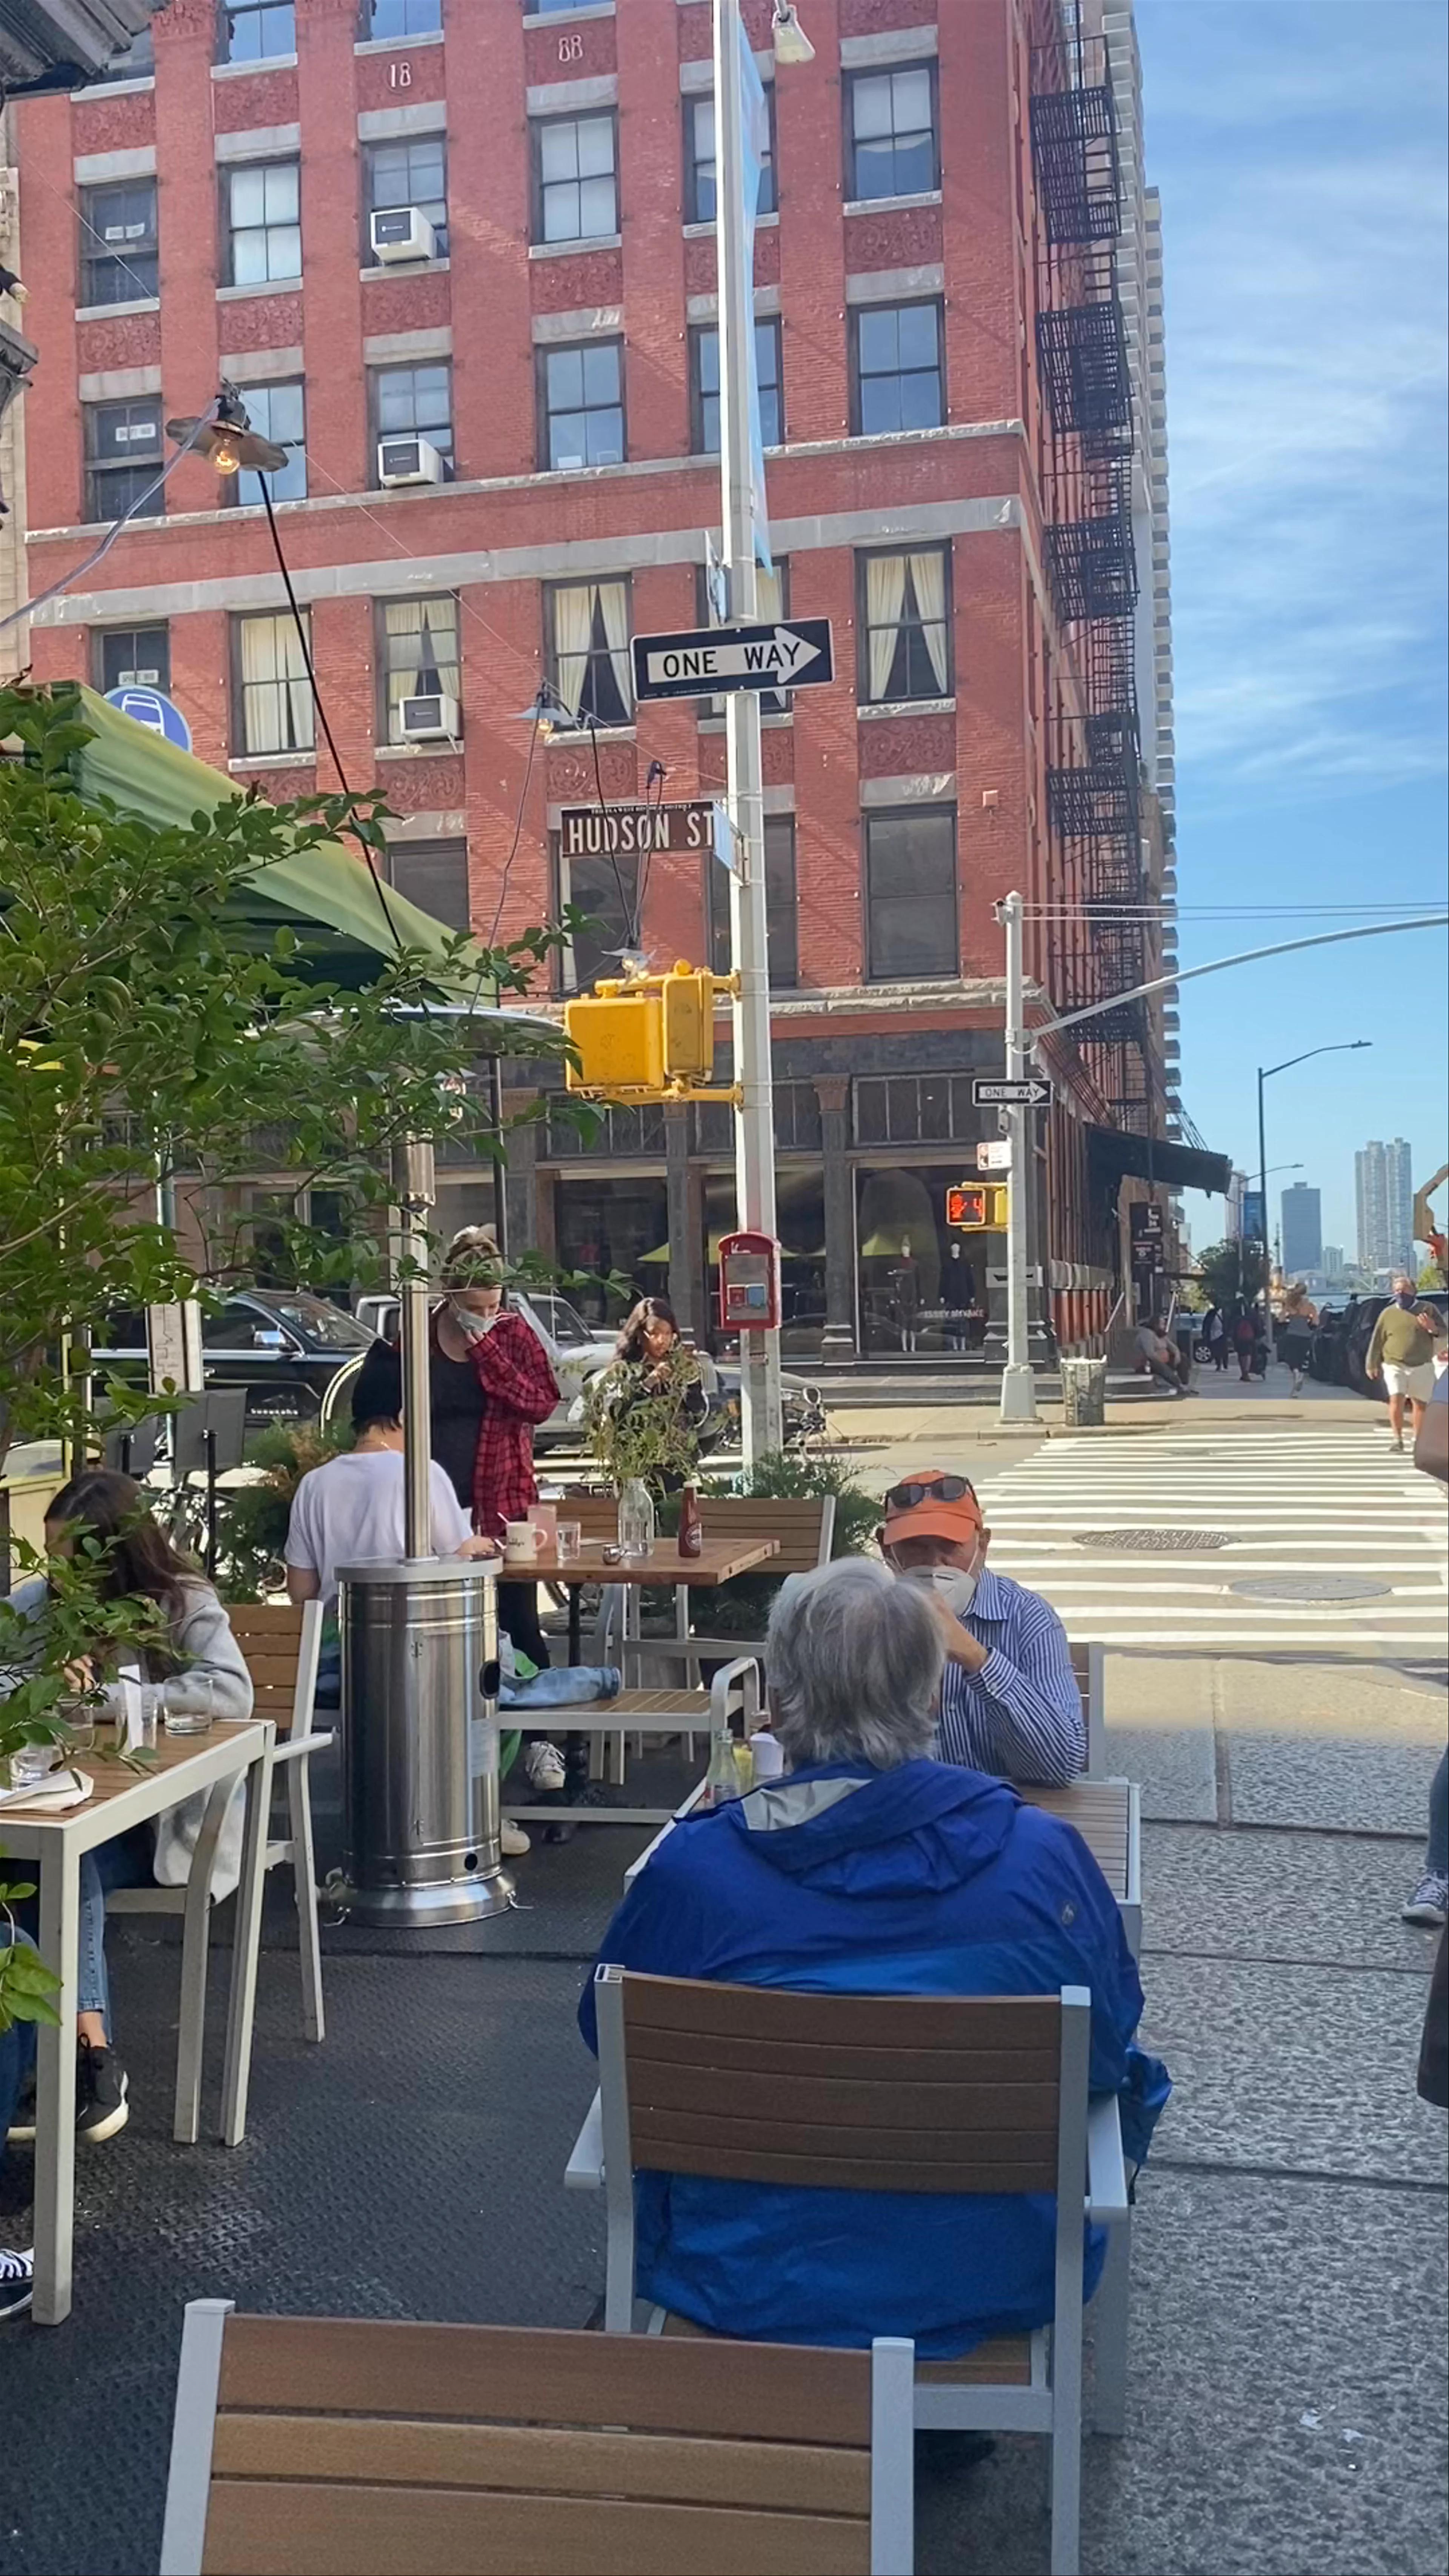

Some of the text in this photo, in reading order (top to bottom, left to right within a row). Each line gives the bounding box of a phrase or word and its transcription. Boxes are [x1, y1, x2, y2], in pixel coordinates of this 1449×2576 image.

[558, 35, 583, 62] 88
[389, 62, 411, 88] 18
[663, 641, 801, 678] ONE WAY
[568, 811, 714, 854] HUDSON ST
[985, 1087, 1039, 1097] ONE WAY
